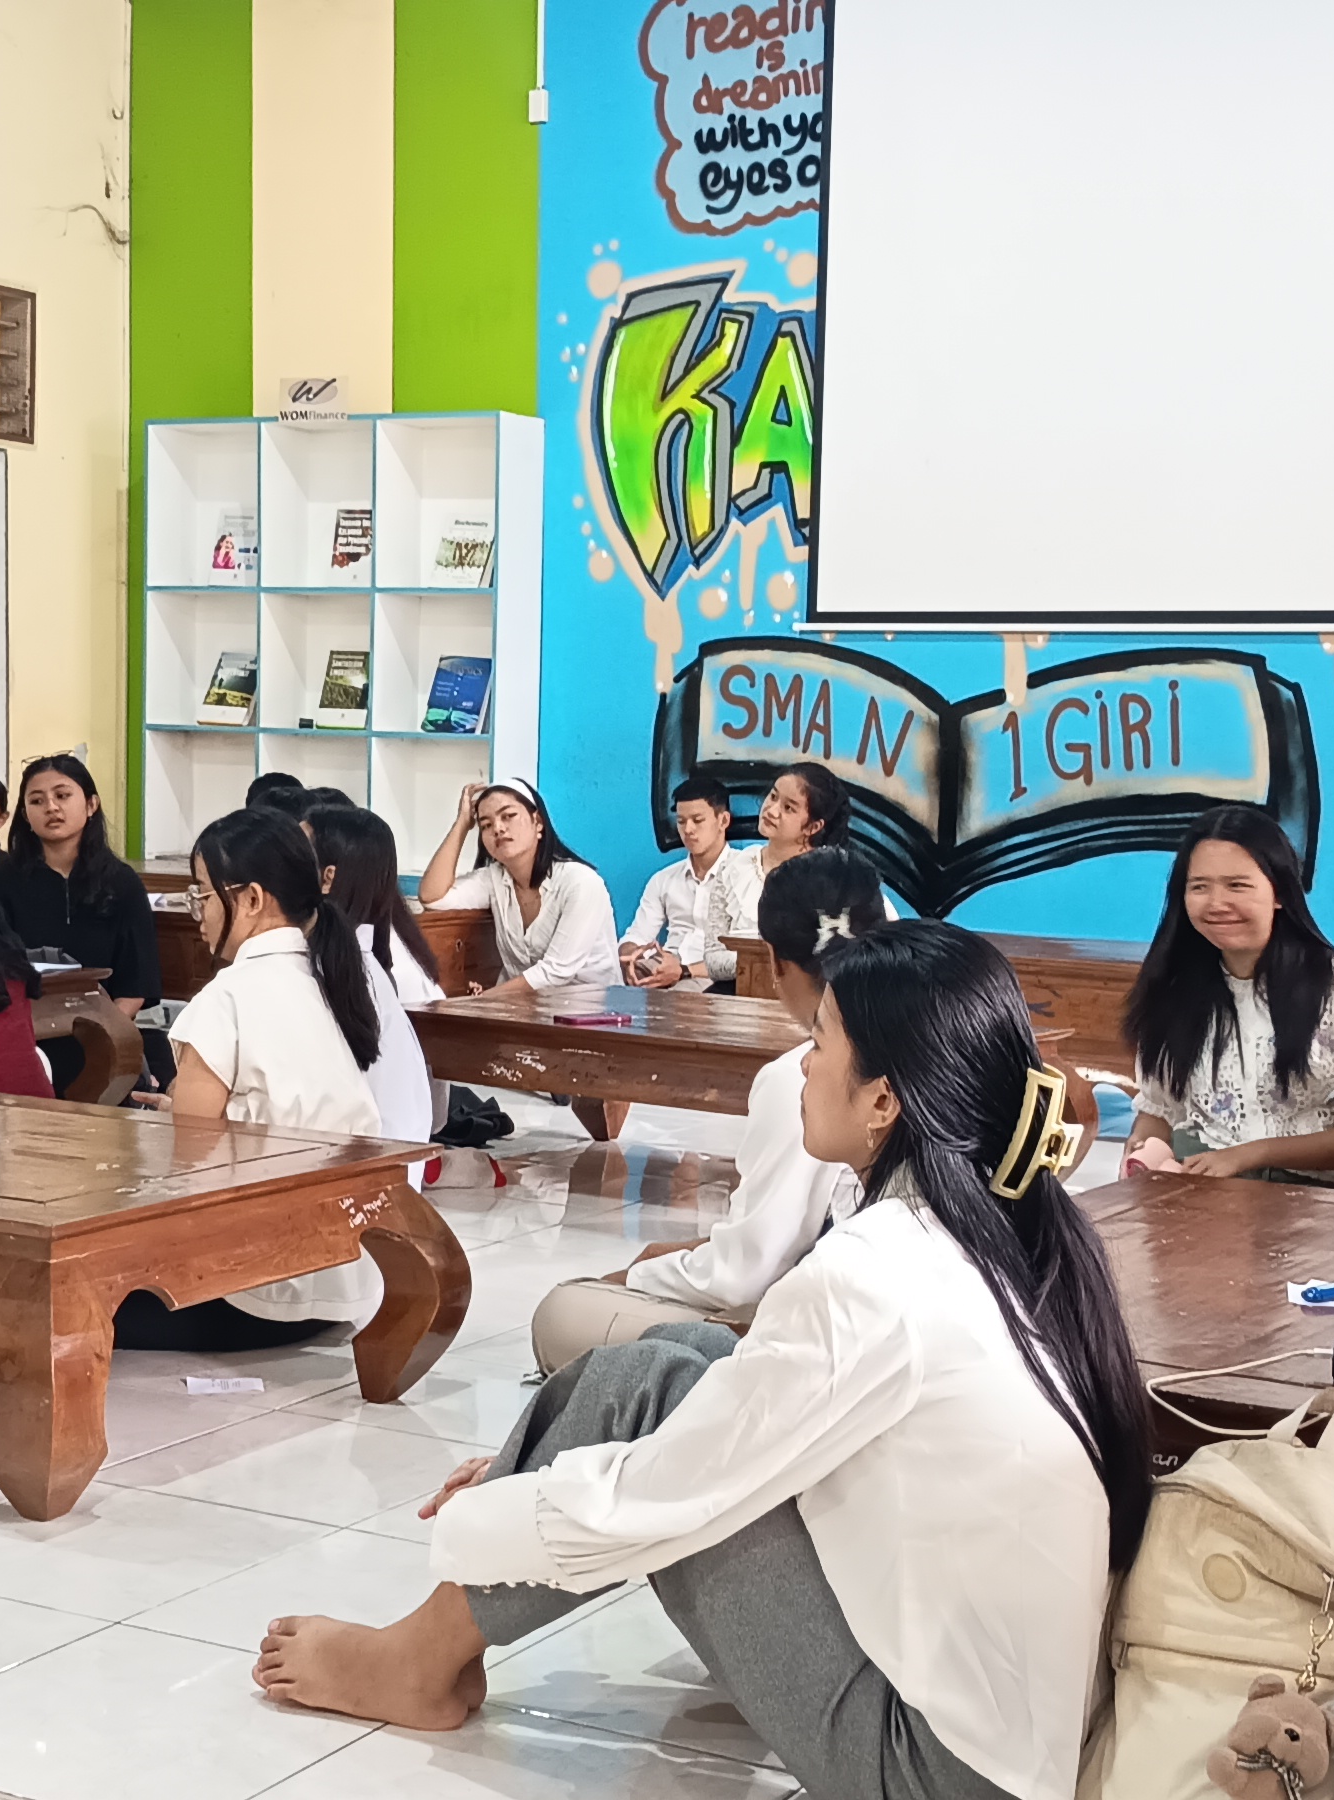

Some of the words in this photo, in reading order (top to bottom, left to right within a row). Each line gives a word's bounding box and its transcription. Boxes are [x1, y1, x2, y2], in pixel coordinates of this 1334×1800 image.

[756, 40, 786, 72] is
[694, 113, 782, 154] with
[699, 161, 792, 215] eyes
[719, 664, 833, 761] SMA
[857, 696, 915, 778] N
[1000, 711, 1028, 802] 1
